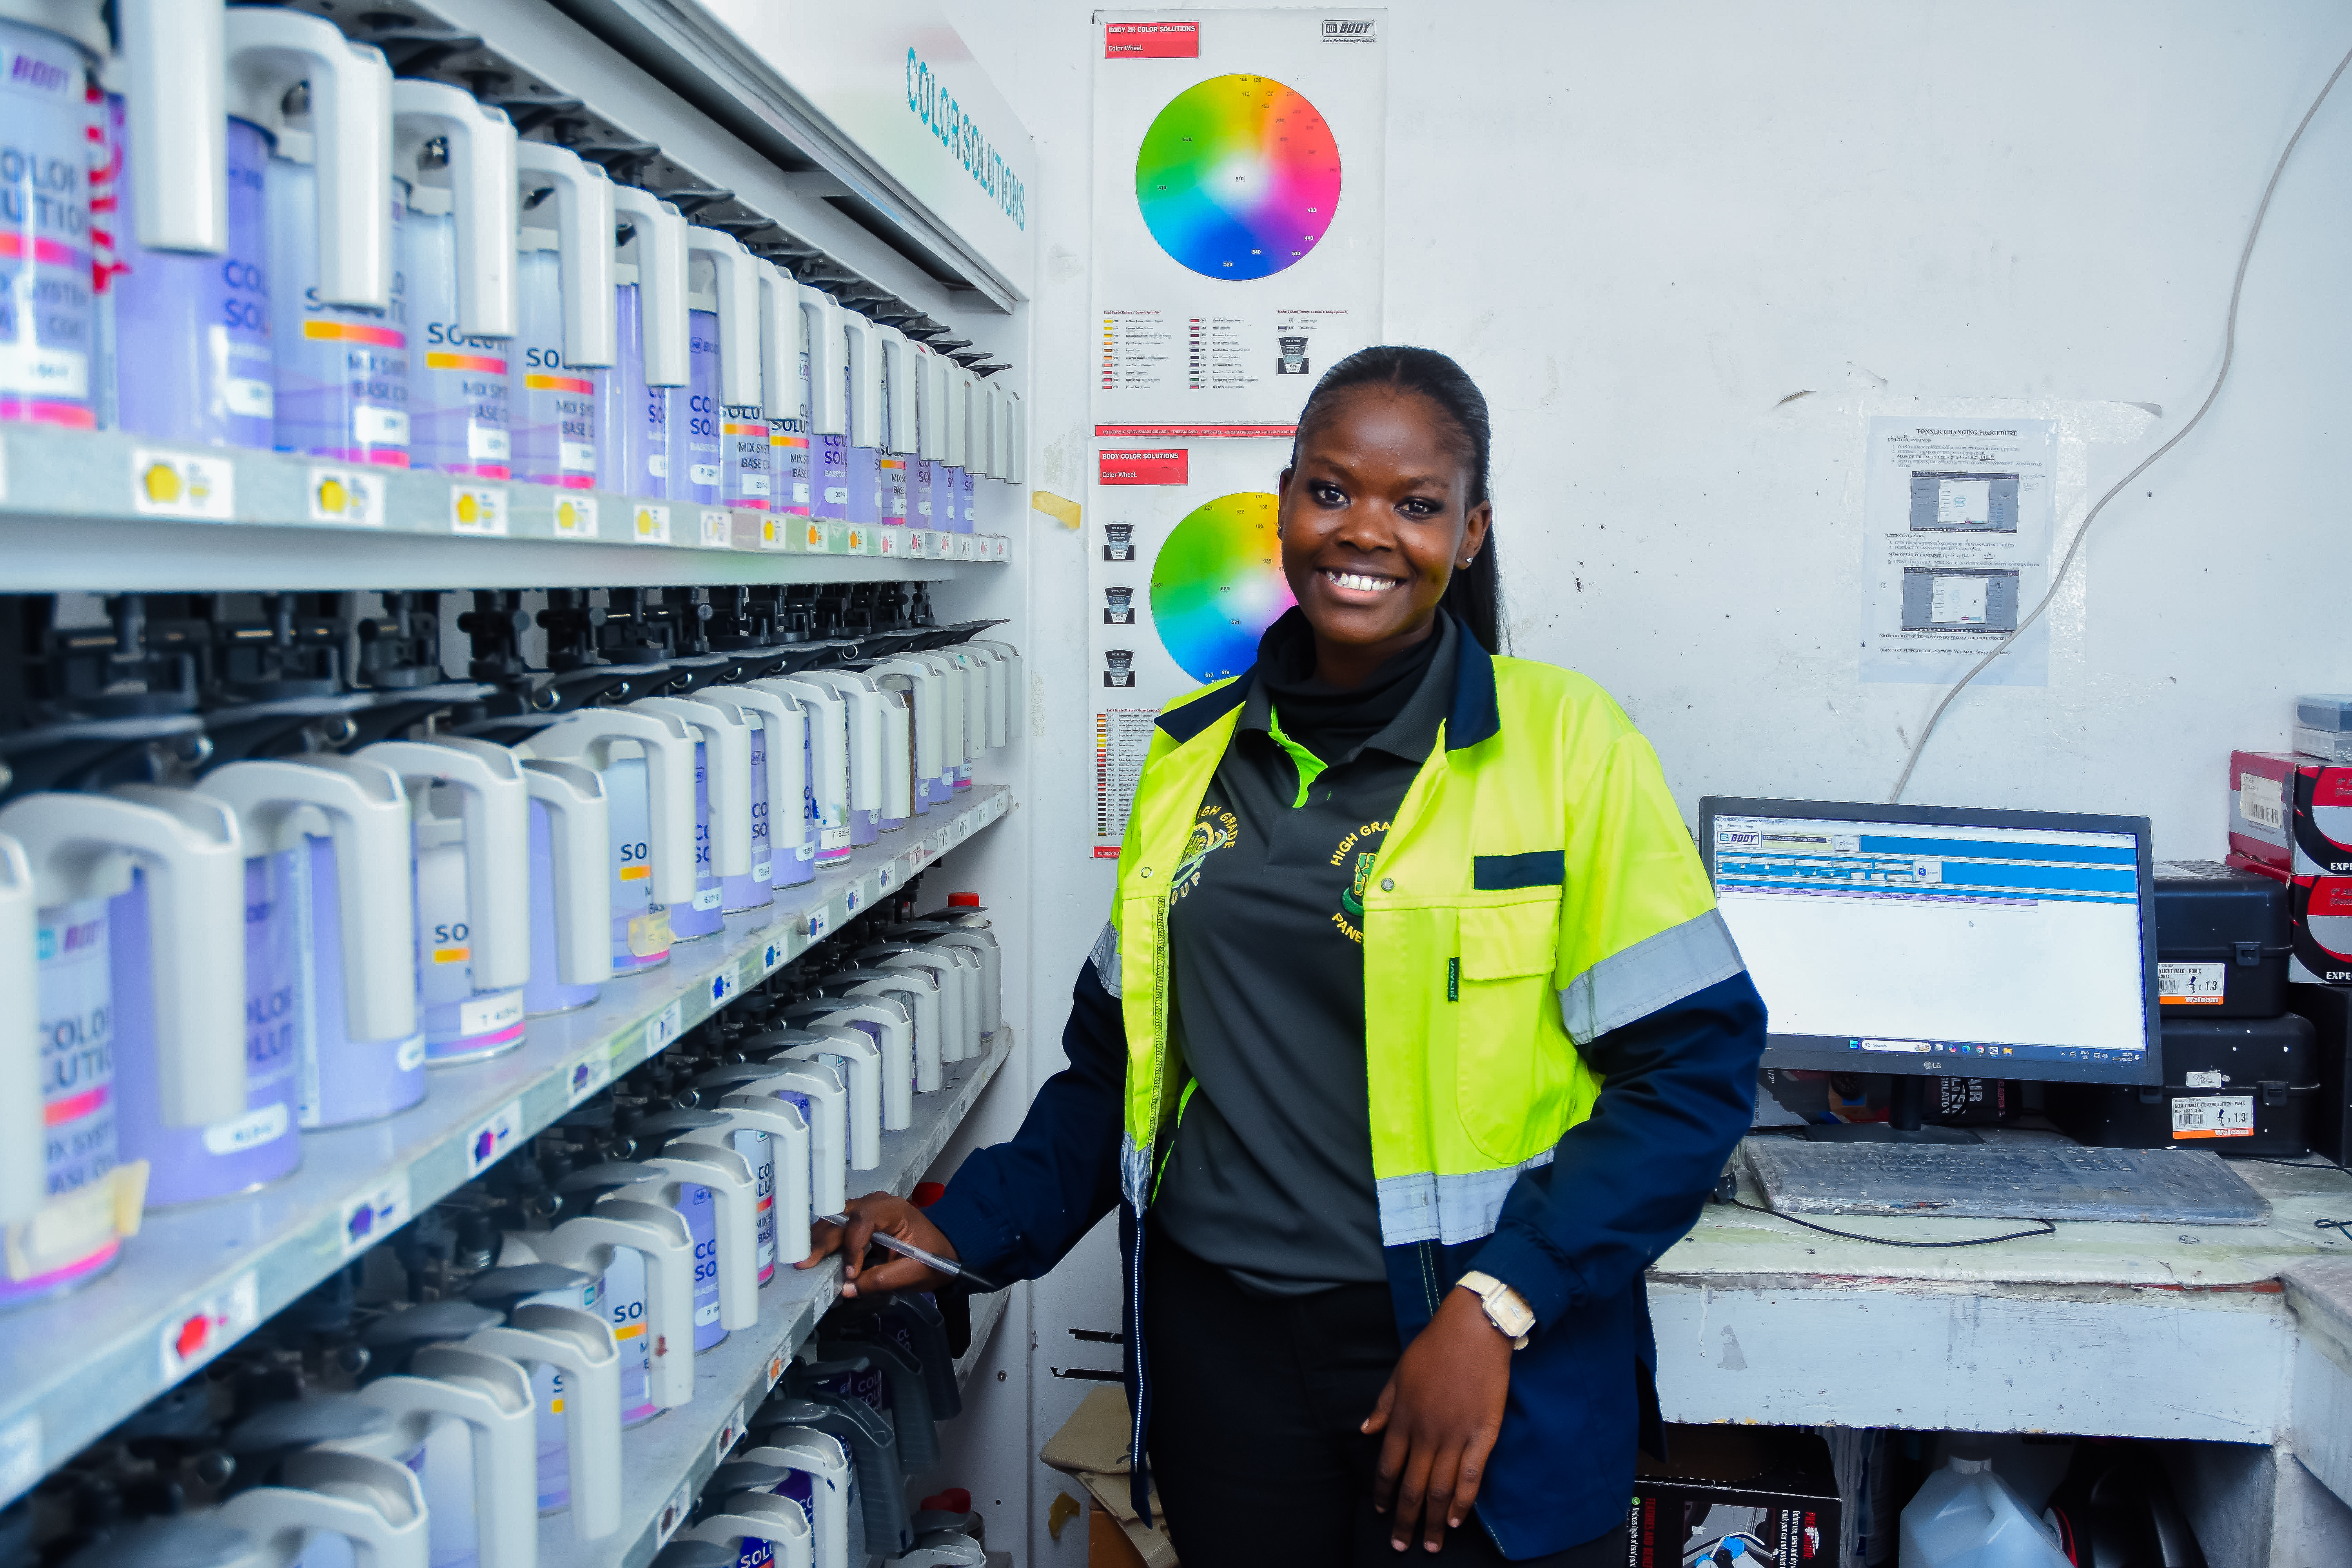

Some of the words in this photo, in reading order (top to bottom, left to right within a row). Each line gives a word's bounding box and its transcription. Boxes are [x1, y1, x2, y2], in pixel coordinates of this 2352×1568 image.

[1339, 23, 1372, 33] BODY
[906, 46, 960, 161] COLOR
[963, 113, 1025, 232] SOLUTIONS
[1220, 812, 1238, 849] GRADE
[1731, 834, 1756, 842] BODY
[621, 842, 647, 862] SO
[1330, 833, 1358, 866] HIGH
[2205, 981, 2217, 990] 1.3
[2234, 1113, 2246, 1123] 1.3
[1631, 1507, 1639, 1525] Reduces
[1644, 1498, 1655, 1530] FEATURES
[1781, 1510, 1789, 1521] mask
[1791, 1510, 1800, 1525] Before
[1780, 1522, 1788, 1532] your
[1643, 1531, 1655, 1545] AND
[1790, 1535, 1798, 1547] clean
[1630, 1545, 1639, 1555] hard
[1790, 1548, 1798, 1557] and
[1629, 1556, 1638, 1567] paint
[1778, 1550, 1788, 1566] protect
